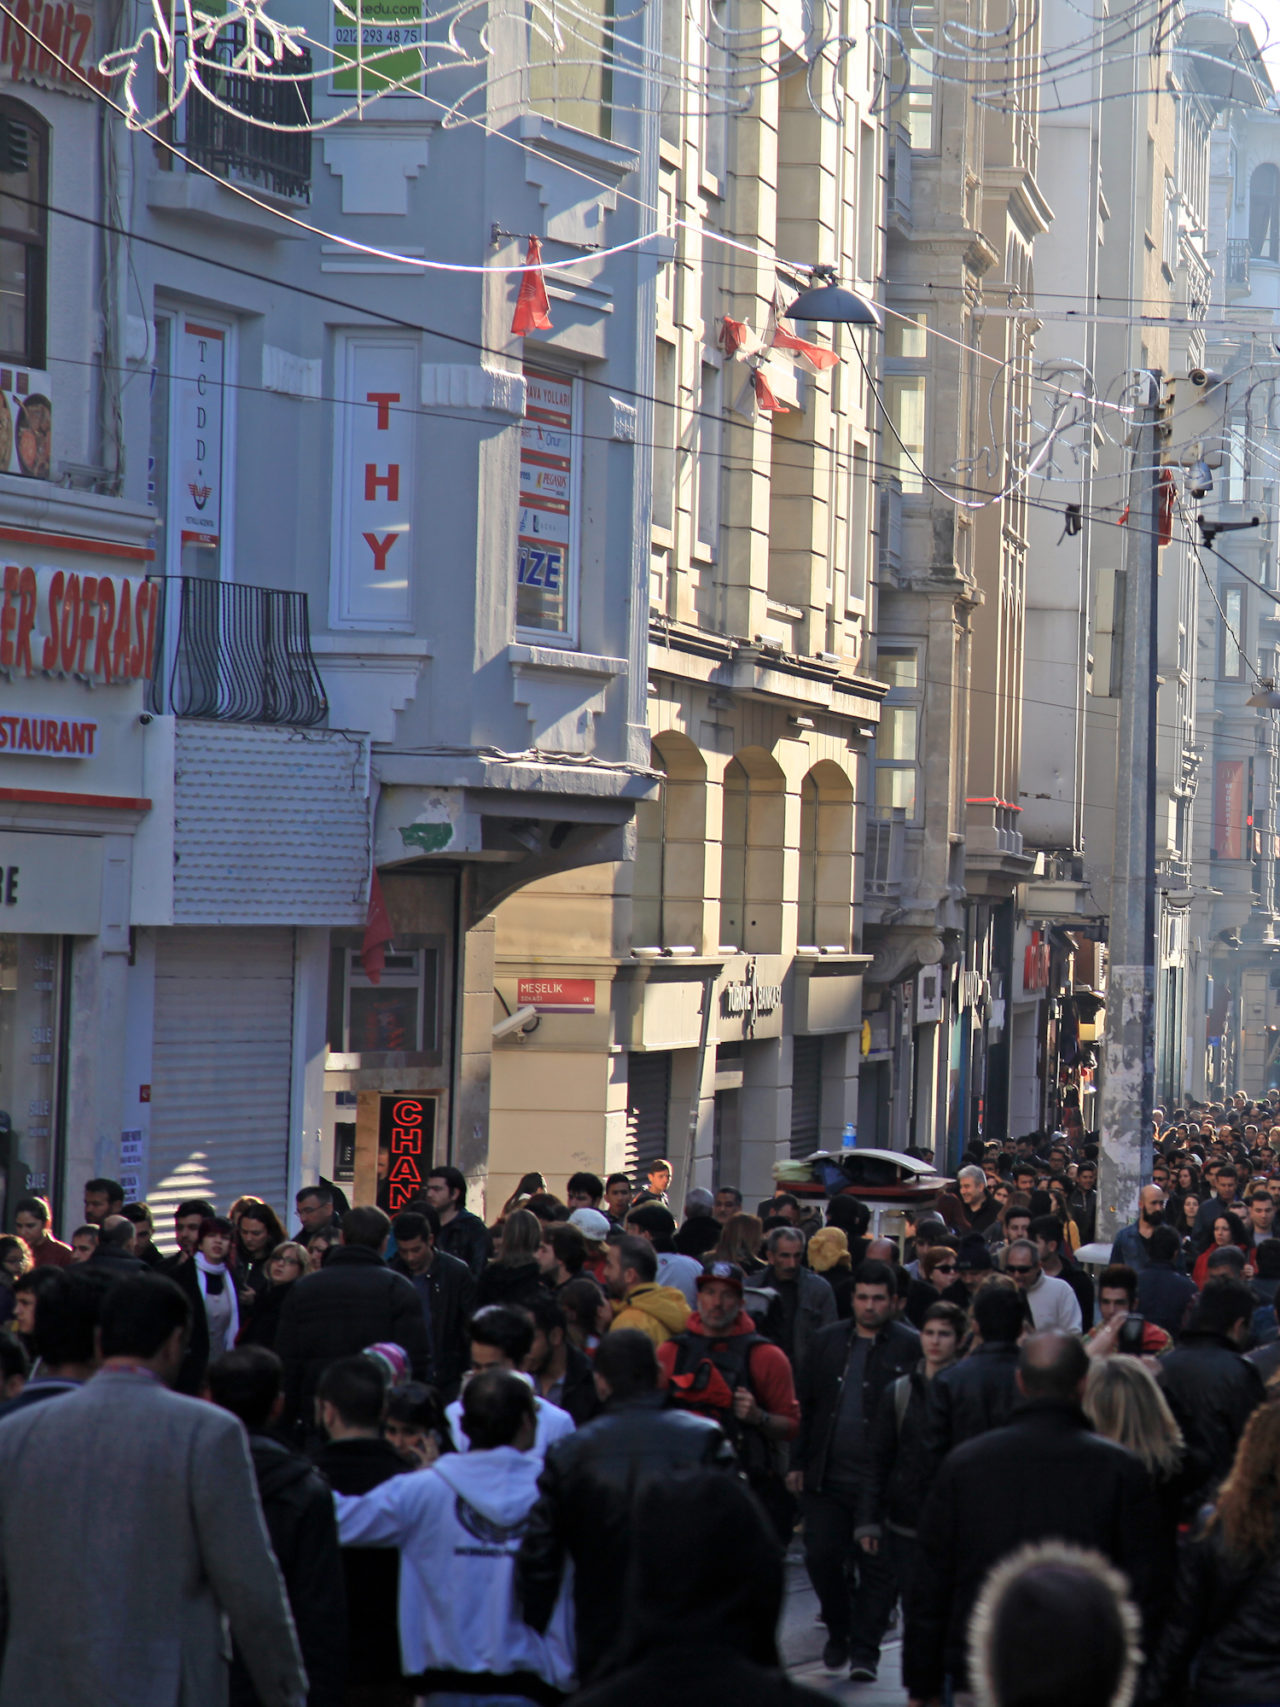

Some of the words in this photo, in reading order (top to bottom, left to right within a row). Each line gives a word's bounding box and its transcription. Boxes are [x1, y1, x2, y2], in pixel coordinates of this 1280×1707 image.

[363, 30, 383, 43] 293
[387, 30, 400, 43] 48
[403, 30, 418, 43] 75
[543, 389, 570, 407] YOLLARI
[362, 392, 400, 571] THY
[521, 981, 563, 995] MEŞELİK
[26, 1174, 47, 1190] SALE
